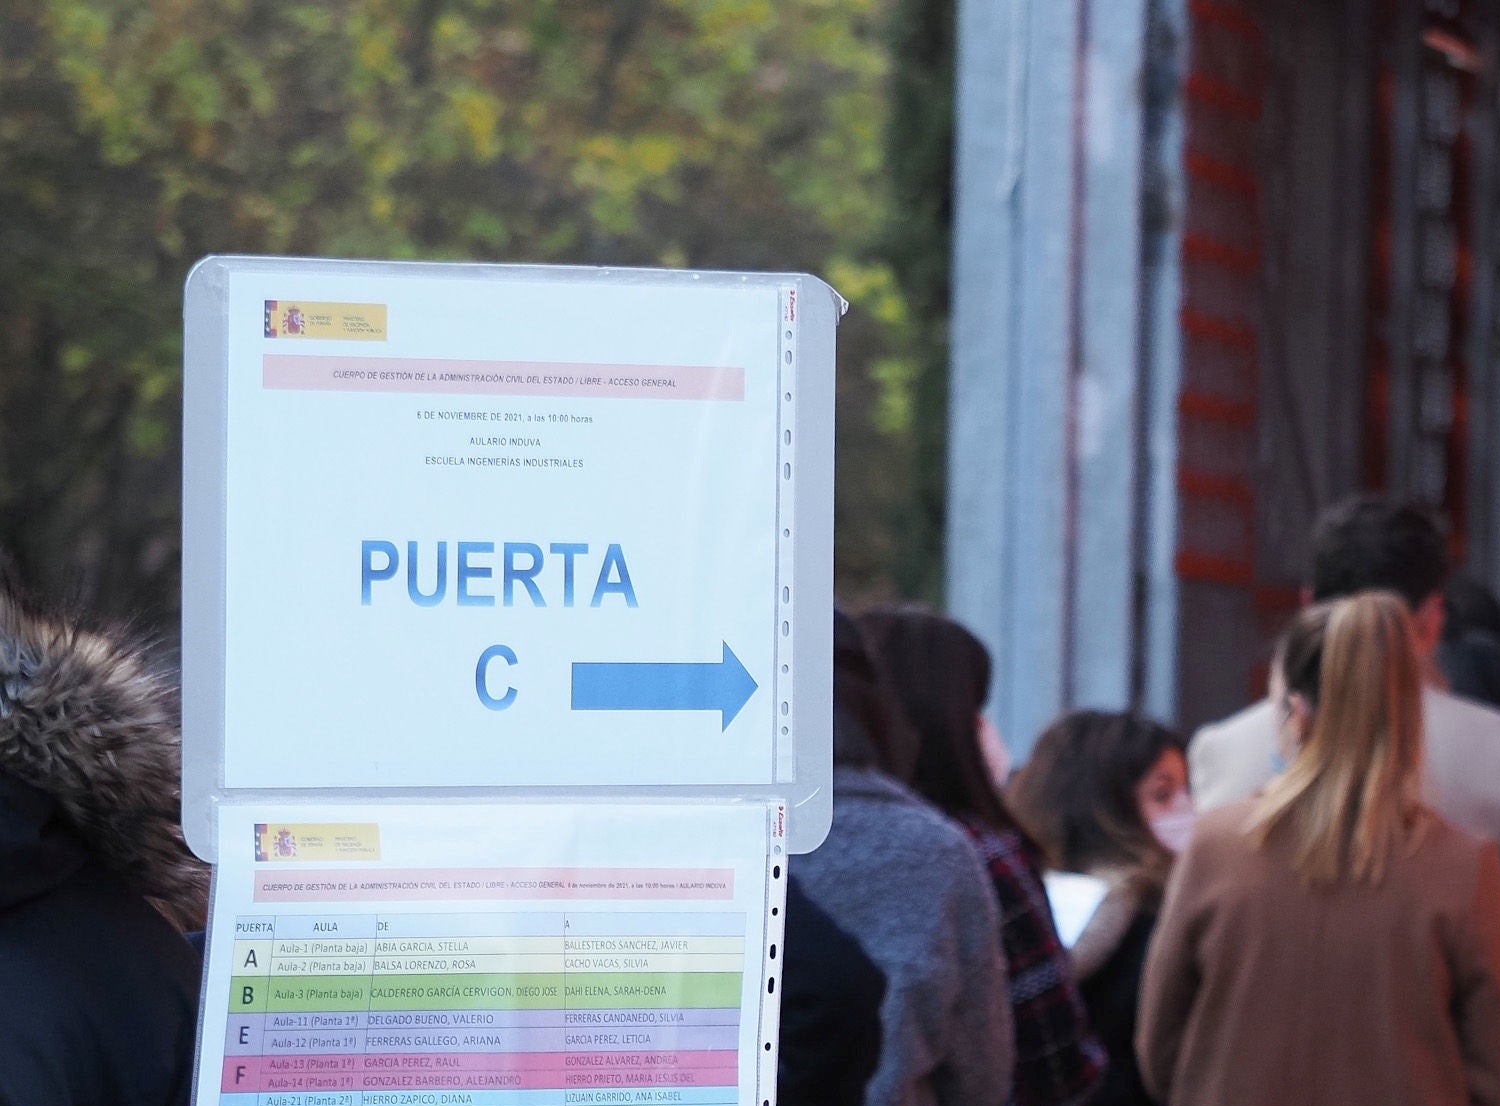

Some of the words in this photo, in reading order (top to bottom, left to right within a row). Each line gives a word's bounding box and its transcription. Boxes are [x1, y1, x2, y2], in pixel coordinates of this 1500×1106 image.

[333, 370, 365, 380] CUERPO
[366, 370, 377, 380] DE
[378, 371, 412, 381] GESTIÓN
[414, 372, 424, 381] DE
[426, 372, 436, 382] LA
[438, 372, 504, 383] ADMINISTRACIÓN
[504, 374, 523, 384] CIVIL
[525, 374, 540, 384] DEL
[542, 375, 573, 385] ESTADO
[579, 375, 601, 386] LIBRE
[607, 376, 639, 386] ACCESO
[640, 377, 677, 387] GENERAL
[423, 410, 435, 421] DE
[437, 410, 488, 422] NOVIEMBRE
[490, 411, 501, 422] DE
[527, 412, 531, 423] a
[534, 412, 545, 423] las
[548, 413, 568, 424] 10:00
[570, 413, 593, 424] horas
[470, 436, 506, 447] AULARIO
[509, 437, 541, 447] INDUVA
[424, 455, 464, 467] ESCUELA
[467, 456, 520, 468] INGENIERÍAS
[523, 457, 584, 469] INDUSTRIALES
[359, 539, 639, 610] PUERTA
[474, 642, 519, 712] C
[236, 922, 273, 934] PUERTA
[313, 921, 338, 933] AULA
[377, 920, 389, 932] DE
[565, 920, 570, 929] A
[376, 942, 396, 952] ABIA
[437, 942, 468, 952] STELLA
[243, 949, 258, 968] A
[374, 960, 402, 970] BALSA
[450, 959, 476, 969] ROSA
[242, 985, 254, 1005] B
[274, 989, 303, 1000] Aula-3
[306, 989, 337, 999] (Planta
[340, 989, 363, 999] baja)
[370, 988, 424, 998] CALDERERO
[425, 988, 460, 998] GARCÍA
[517, 987, 540, 996] DIEGO
[542, 986, 558, 996] JOSE
[273, 1016, 307, 1027] Aula-11
[310, 1016, 342, 1026] (Planta
[368, 1015, 412, 1025] DELGADO
[452, 1014, 494, 1024] VALERIO
[564, 1013, 602, 1023] FERRERAS
[659, 1012, 684, 1022] SILVIA
[239, 1025, 249, 1045] E
[271, 1037, 306, 1048] Aula-12
[308, 1037, 340, 1048] (Planta
[366, 1037, 412, 1047] FERRERAS
[462, 1036, 501, 1046] ARIANA
[235, 1066, 246, 1085] F
[267, 1096, 300, 1106] Aula-21
[304, 1096, 336, 1106] (Planta
[363, 1095, 397, 1104] HIERRO
[440, 1094, 472, 1104] DIANA
